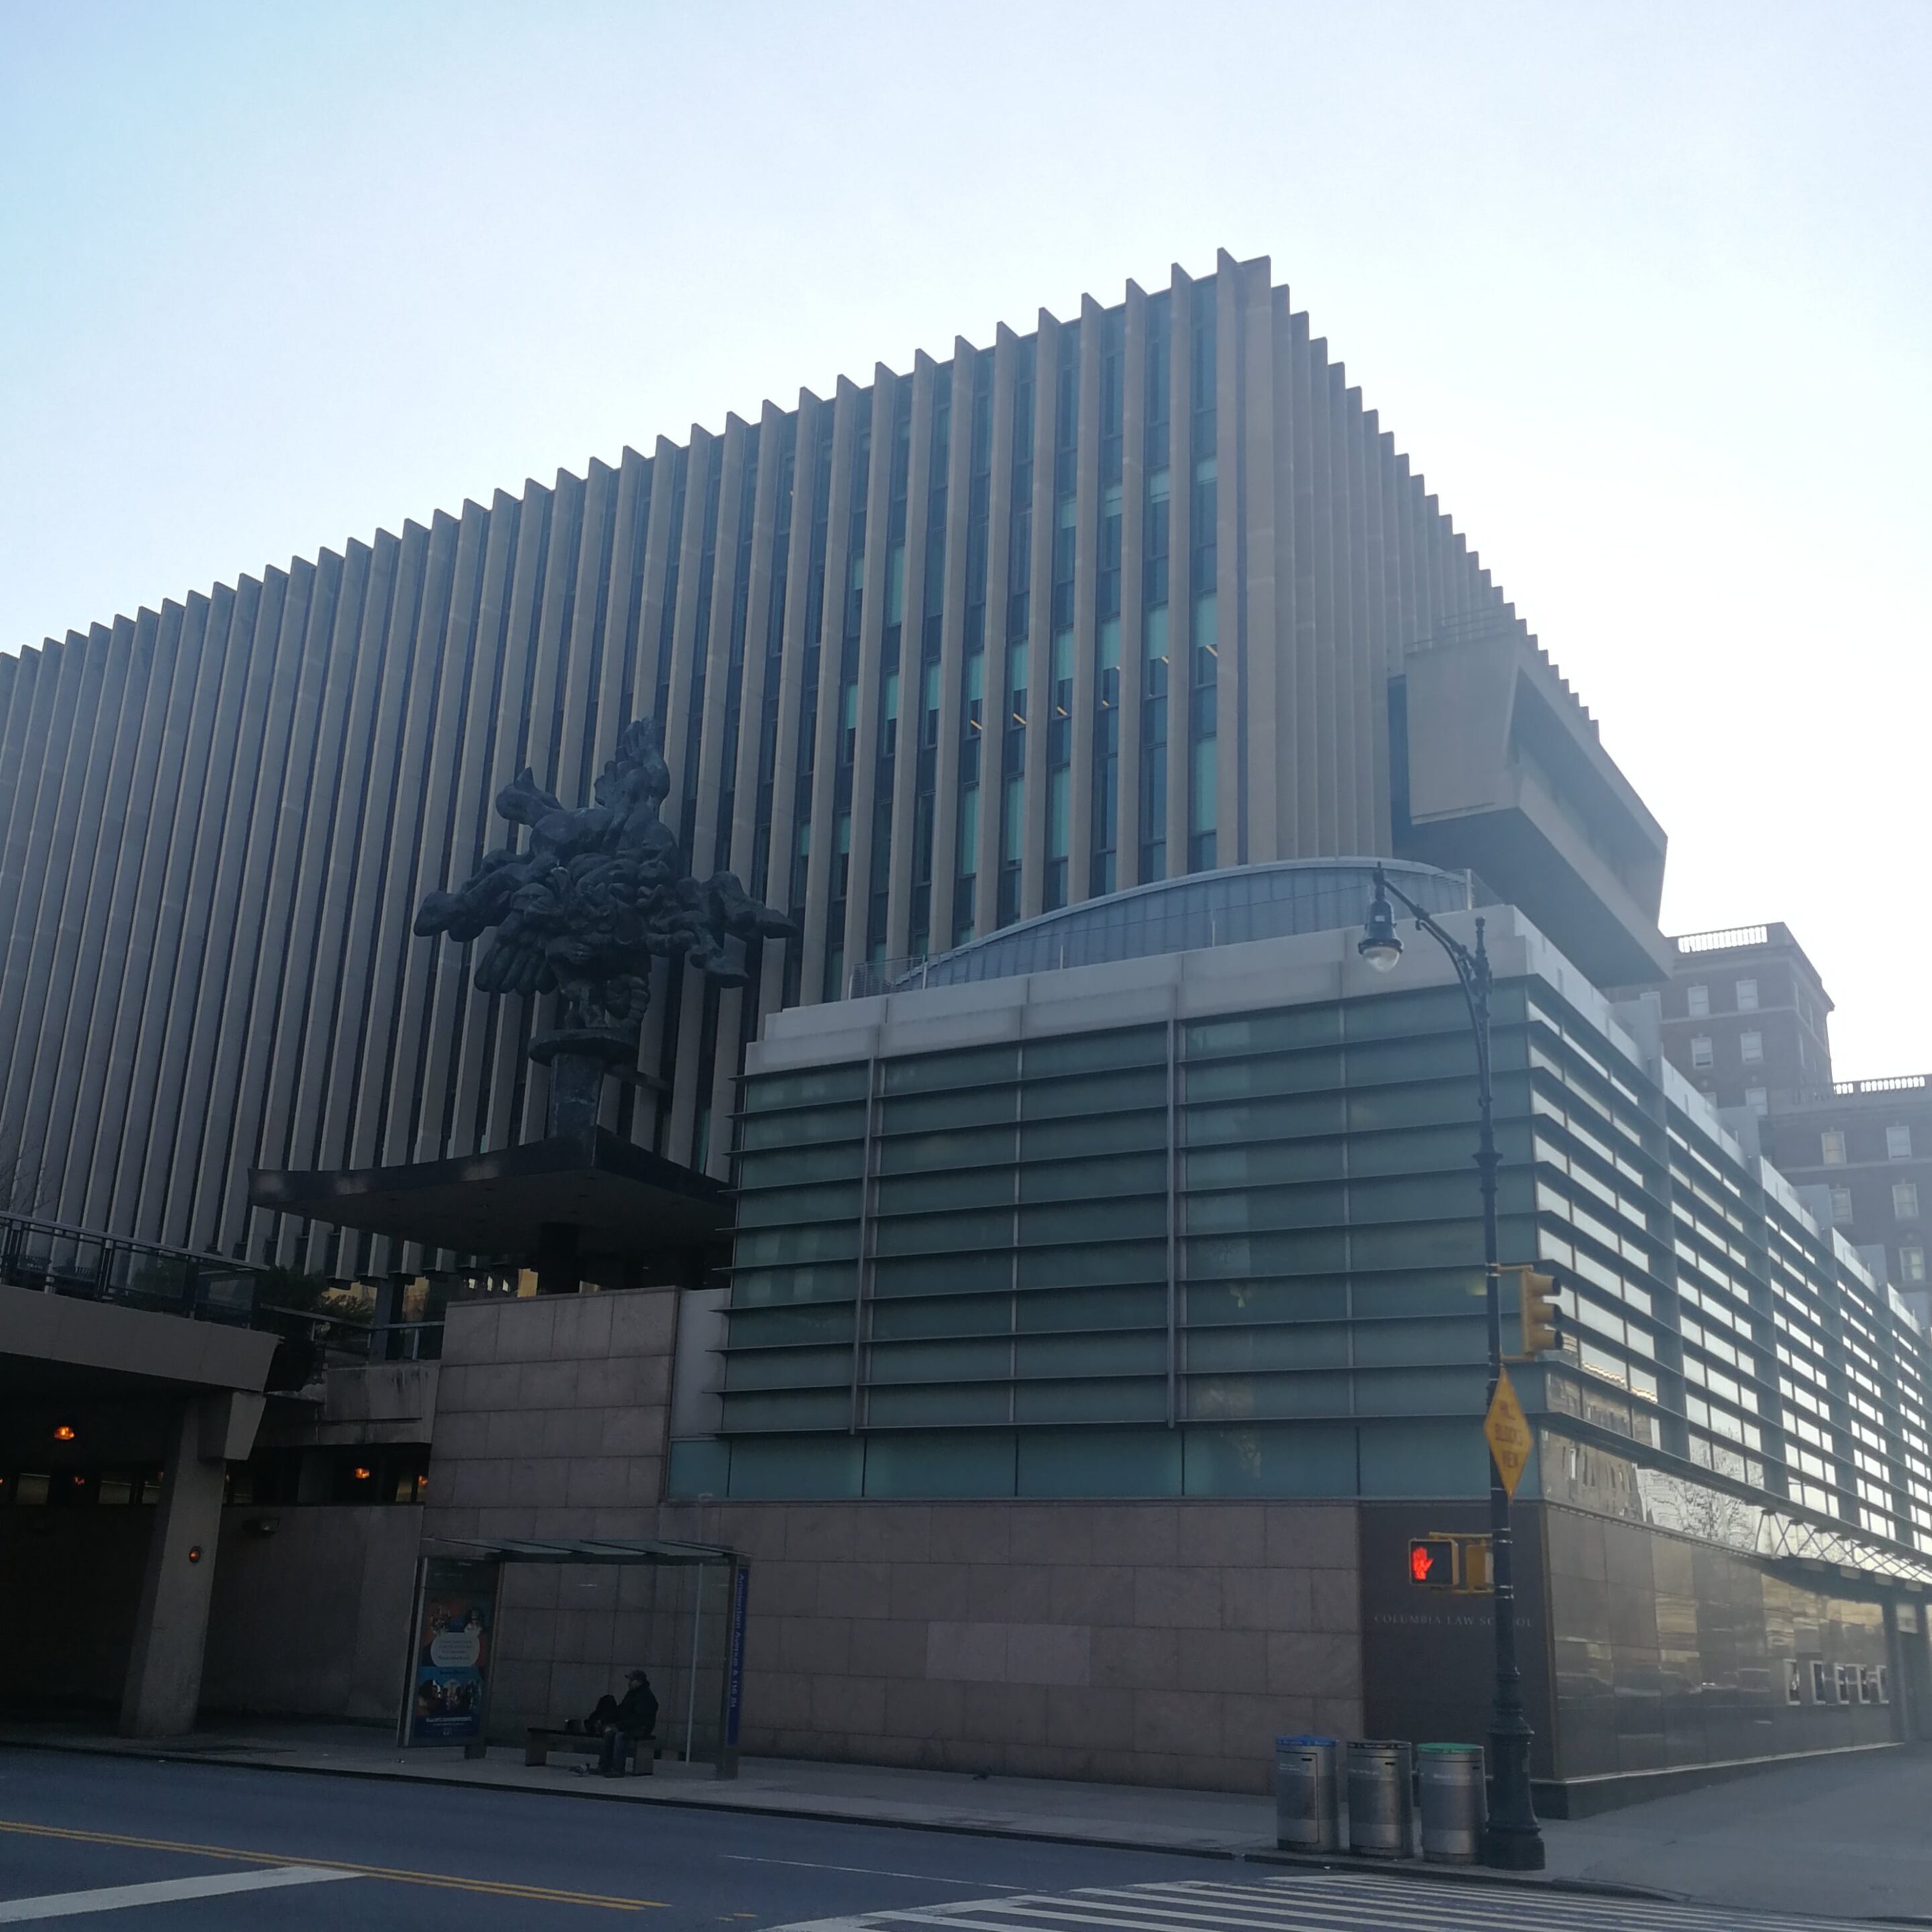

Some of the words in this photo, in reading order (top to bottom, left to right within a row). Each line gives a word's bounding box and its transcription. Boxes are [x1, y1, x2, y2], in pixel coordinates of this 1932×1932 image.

[736, 1574, 745, 1628] Amsterdam
[1374, 1614, 1442, 1625] COLUMBIA
[1446, 1615, 1474, 1625] LAW
[1479, 1616, 1532, 1627] SCOL
[733, 1631, 741, 1666] Avenue
